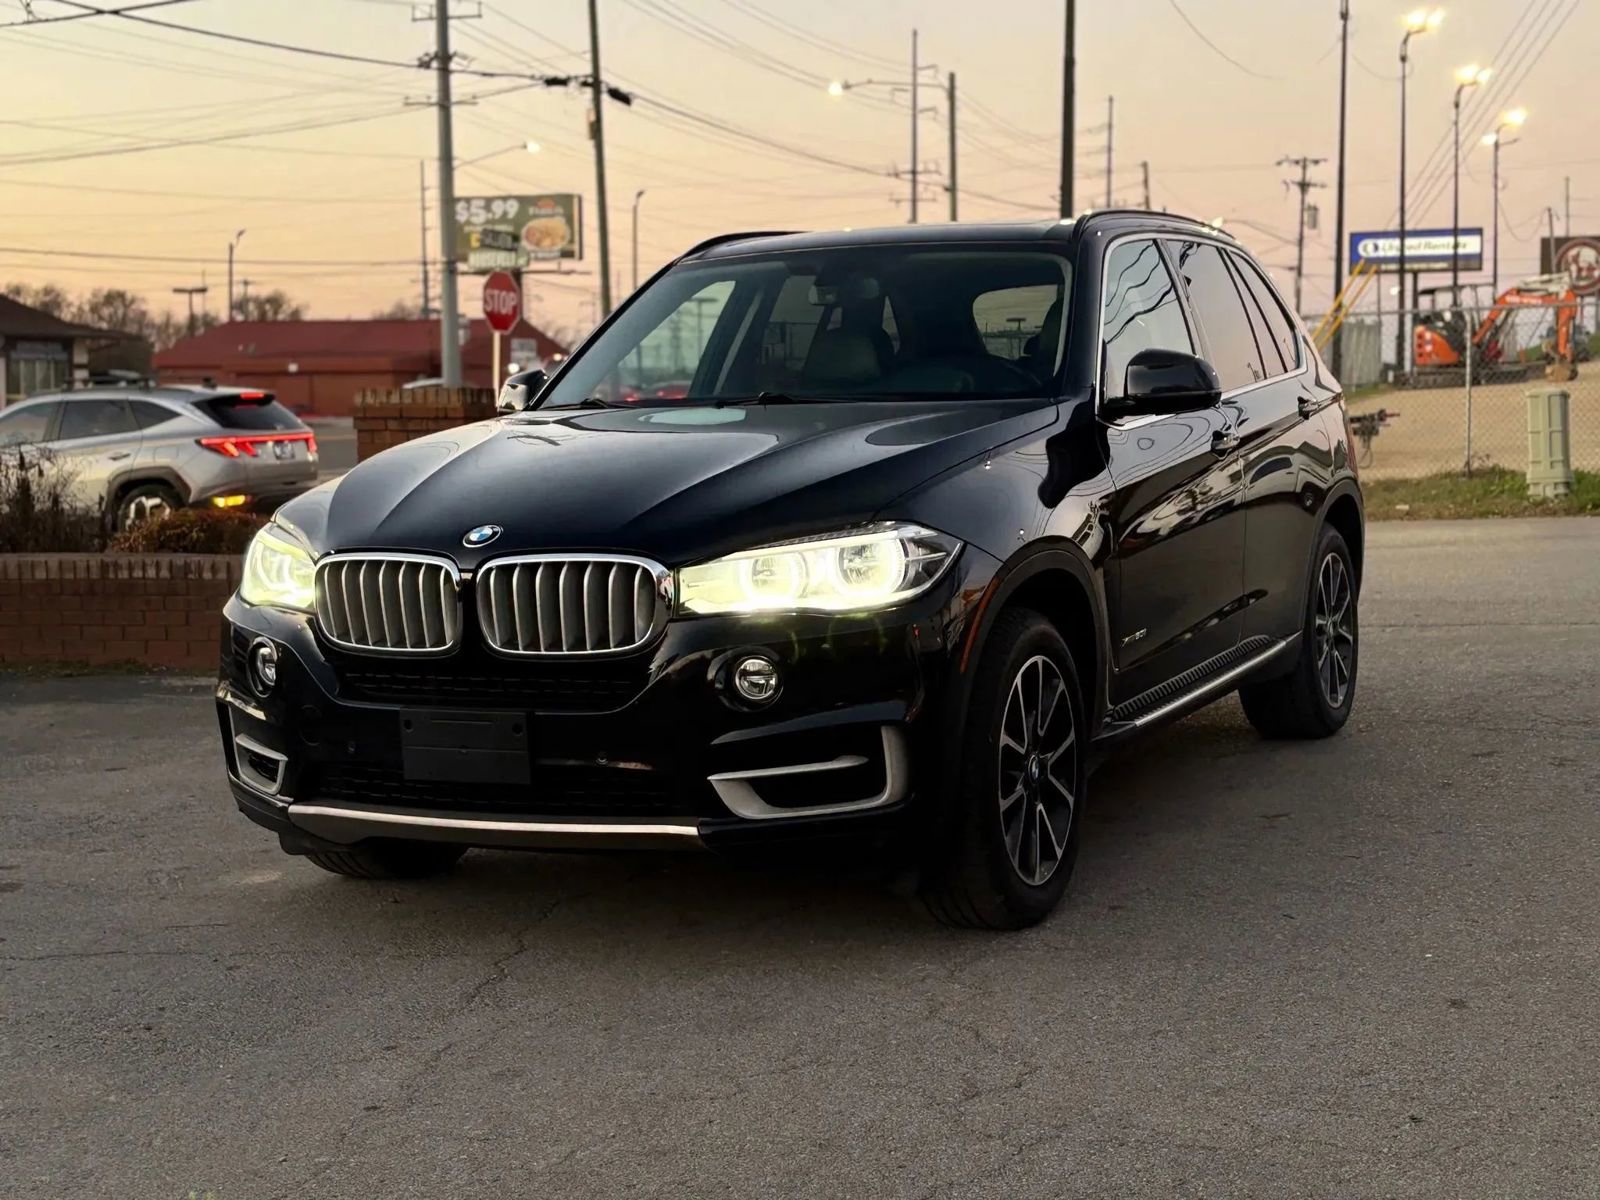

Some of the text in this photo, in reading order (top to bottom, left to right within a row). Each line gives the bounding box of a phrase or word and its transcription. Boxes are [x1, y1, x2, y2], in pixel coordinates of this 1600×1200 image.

[455, 199, 519, 224] $5.99
[1382, 239, 1467, 252] Unted Rentls
[484, 289, 517, 315] STOP
